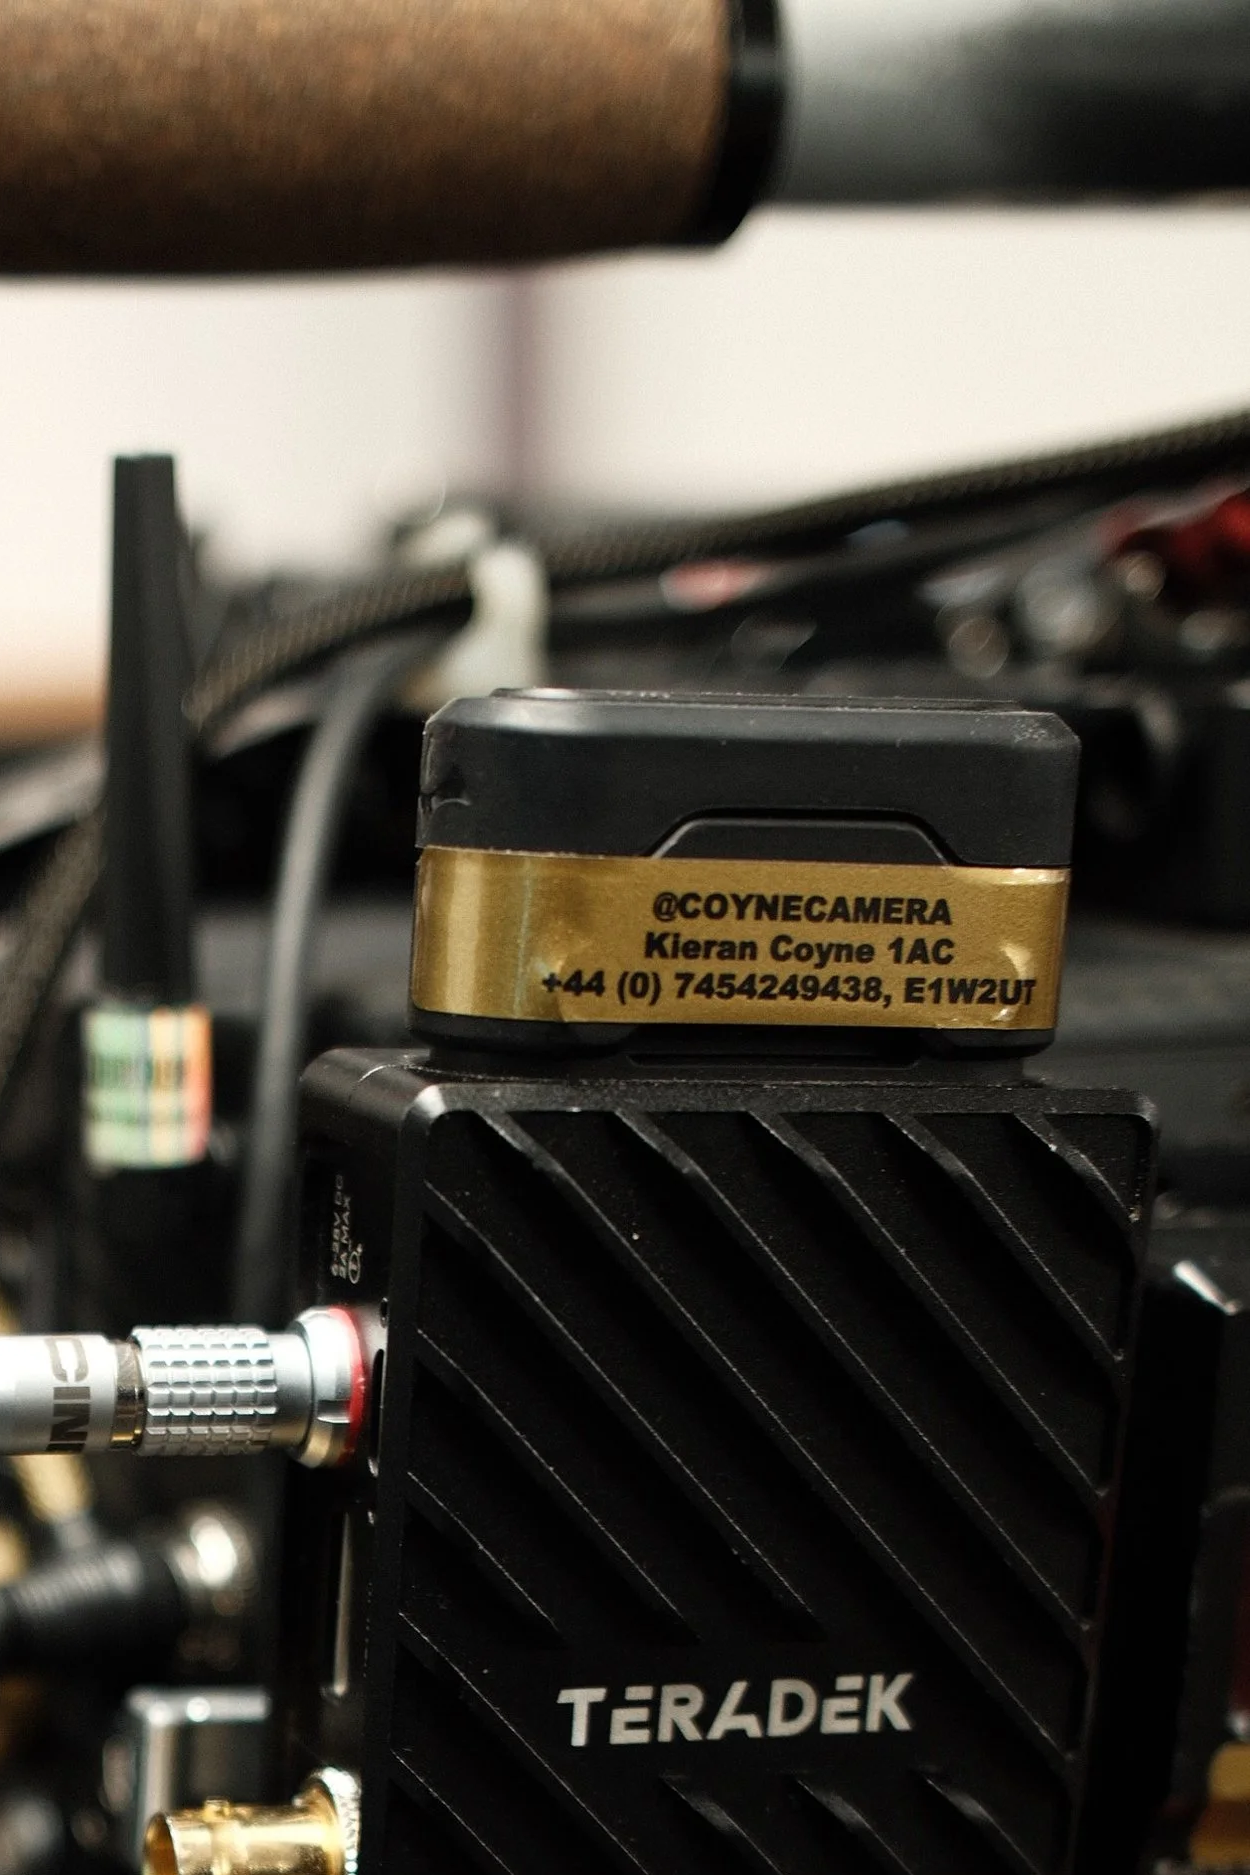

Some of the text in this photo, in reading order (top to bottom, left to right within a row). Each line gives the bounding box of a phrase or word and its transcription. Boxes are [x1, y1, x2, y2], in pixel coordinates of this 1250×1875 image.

[652, 891, 953, 925] @COYNECAMERA
[644, 931, 956, 969] Kieran Coyne 1AC
[541, 968, 1037, 1009] +44 (0) 7454249438, E1W2UT
[340, 1196, 352, 1244] MAX
[556, 1673, 915, 1747] TERADEK
